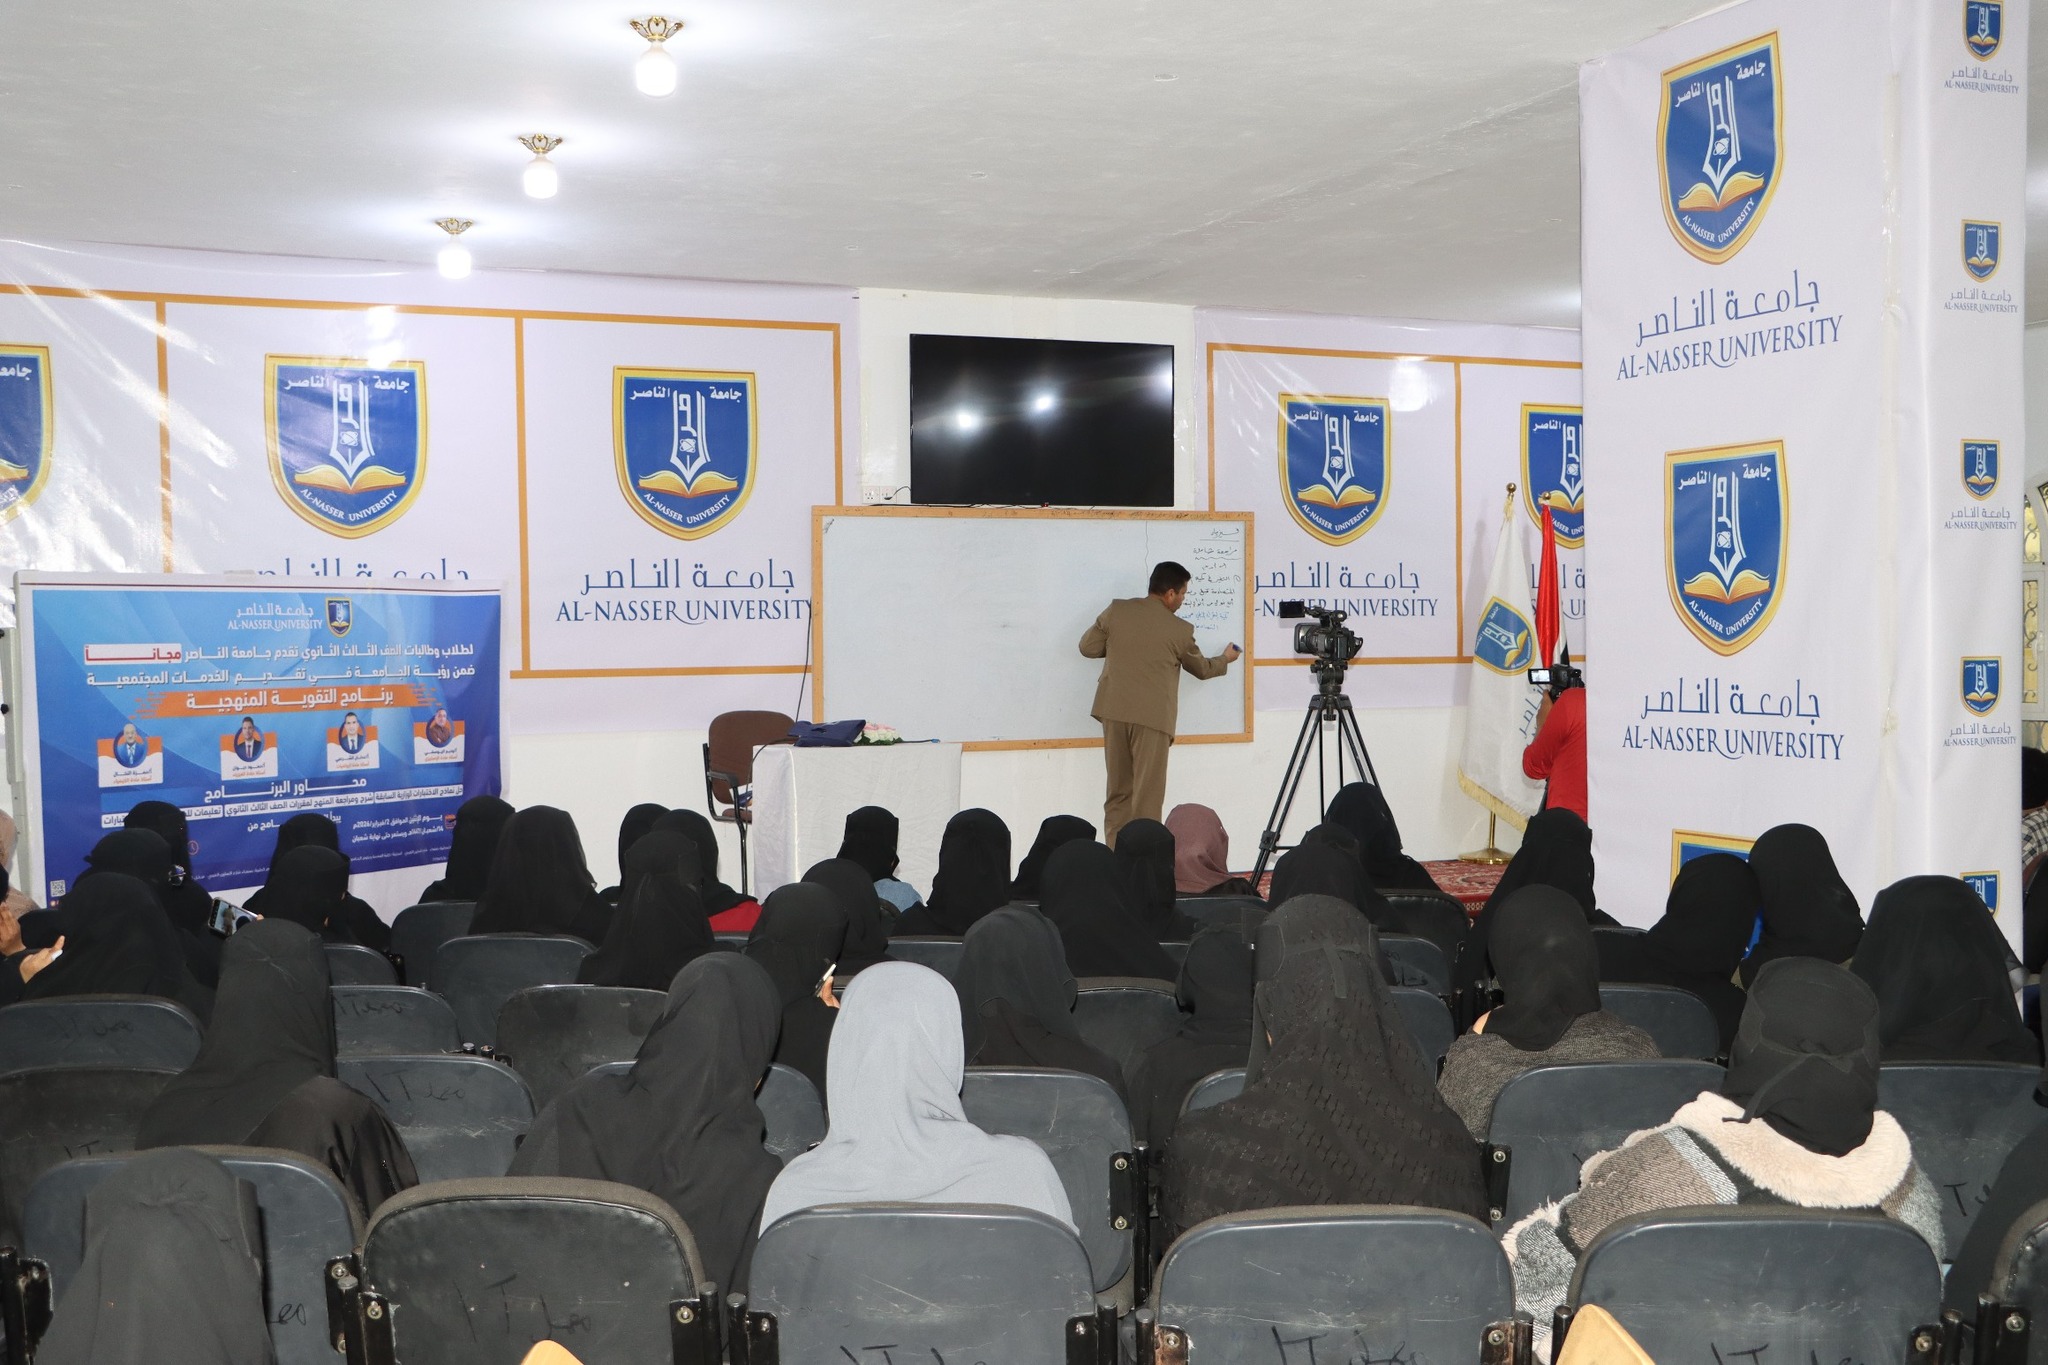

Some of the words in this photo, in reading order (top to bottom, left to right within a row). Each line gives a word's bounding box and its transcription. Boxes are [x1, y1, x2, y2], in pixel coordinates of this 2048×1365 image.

[1736, 59, 1766, 80] جامعة
[1951, 66, 1980, 79] الناصر
[1983, 69, 2013, 83] جامعة
[1675, 82, 1704, 107] الناصر
[1944, 80, 1979, 91] AL-NASSER
[1980, 82, 2019, 94] UNIVERSITY
[1683, 214, 1715, 243] AL-NASSER
[1718, 197, 1755, 243] UNIVERSITY
[1725, 269, 1820, 319] جامعة
[1950, 288, 1979, 300] الناصر
[1981, 289, 2012, 303] جامعة
[1944, 302, 1979, 312] AL-NASSER
[1980, 303, 2018, 313] UNIVERSITY
[1635, 289, 1716, 347] الناصر
[1616, 341, 1714, 381] AL-NASSER
[1719, 315, 1844, 366] UNIVERSITY
[0, 363, 32, 381] جامع
[285, 376, 329, 390] الناصر
[373, 376, 410, 393] جامعة
[630, 387, 671, 400] الناصر
[710, 386, 742, 403] جامعة
[1293, 410, 1323, 422] الناصر
[1354, 410, 1379, 425] جامعة
[1533, 419, 1562, 431] الناصر
[1743, 463, 1772, 481] جامعة
[1678, 471, 1711, 490] الناصر
[301, 488, 345, 520] AL-NASSER
[349, 490, 397, 521] UNIVERSITY
[644, 492, 683, 522] AL-NASSER
[687, 495, 731, 524] UNIVERSITY
[1951, 506, 1979, 519] الناصر
[1302, 504, 1333, 530] AL-NASSER
[1335, 505, 1370, 532] UNIVERSITY
[1982, 507, 2010, 520] جامعة
[1944, 521, 1979, 530] AL-NASSER
[1980, 521, 2017, 531] UNIVERSITY
[581, 558, 681, 595] الناصر
[692, 558, 796, 594] جامعة
[1254, 562, 1330, 594] الناصر
[1339, 562, 1420, 594] جامعة
[236, 602, 274, 618] الناصر
[275, 602, 314, 617] جامعة
[556, 600, 686, 624] AL-NASSER
[687, 599, 812, 621] UNIVERSITY
[1335, 599, 1440, 617] UNIVERSITY
[1688, 599, 1723, 634] AL-NASSER
[1726, 598, 1763, 635] UNIVERSITY
[228, 619, 274, 630] AL-NASSER
[274, 619, 323, 631] UNIVERSITY
[184, 646, 229, 663] الناصر
[232, 646, 271, 661] جامعة
[274, 645, 299, 661] تقدم
[302, 644, 340, 662] الثانوي
[342, 643, 378, 657] الثالث
[404, 643, 440, 659] وطالبات
[442, 644, 474, 658] لطلاب
[171, 669, 229, 685] الخدمات
[308, 666, 353, 685] في
[354, 665, 411, 681] الجامعة
[413, 666, 451, 680] رؤية
[452, 664, 476, 678] ضمن
[87, 671, 169, 688] المجتمعية
[186, 690, 267, 712] المنهجية
[271, 688, 337, 708] التقوية
[341, 687, 394, 706] برنامج
[1641, 678, 1720, 719] الناصر
[1730, 679, 1821, 726] جامعة
[1950, 723, 1979, 737] الناصر
[1982, 722, 2011, 735] جامعة
[1622, 725, 1722, 753] AL-NASSER
[1725, 730, 1845, 761] UNIVERSITY
[1943, 737, 1979, 747] AL-NASSER
[1980, 736, 2016, 746] UNIVERSITY
[204, 780, 291, 804] البرنامج
[336, 795, 359, 805] ومراجعة
[194, 806, 222, 817] تعليمات
[227, 804, 249, 815] الثانوي
[250, 802, 268, 812] الثالث
[270, 801, 287, 810] الصف
